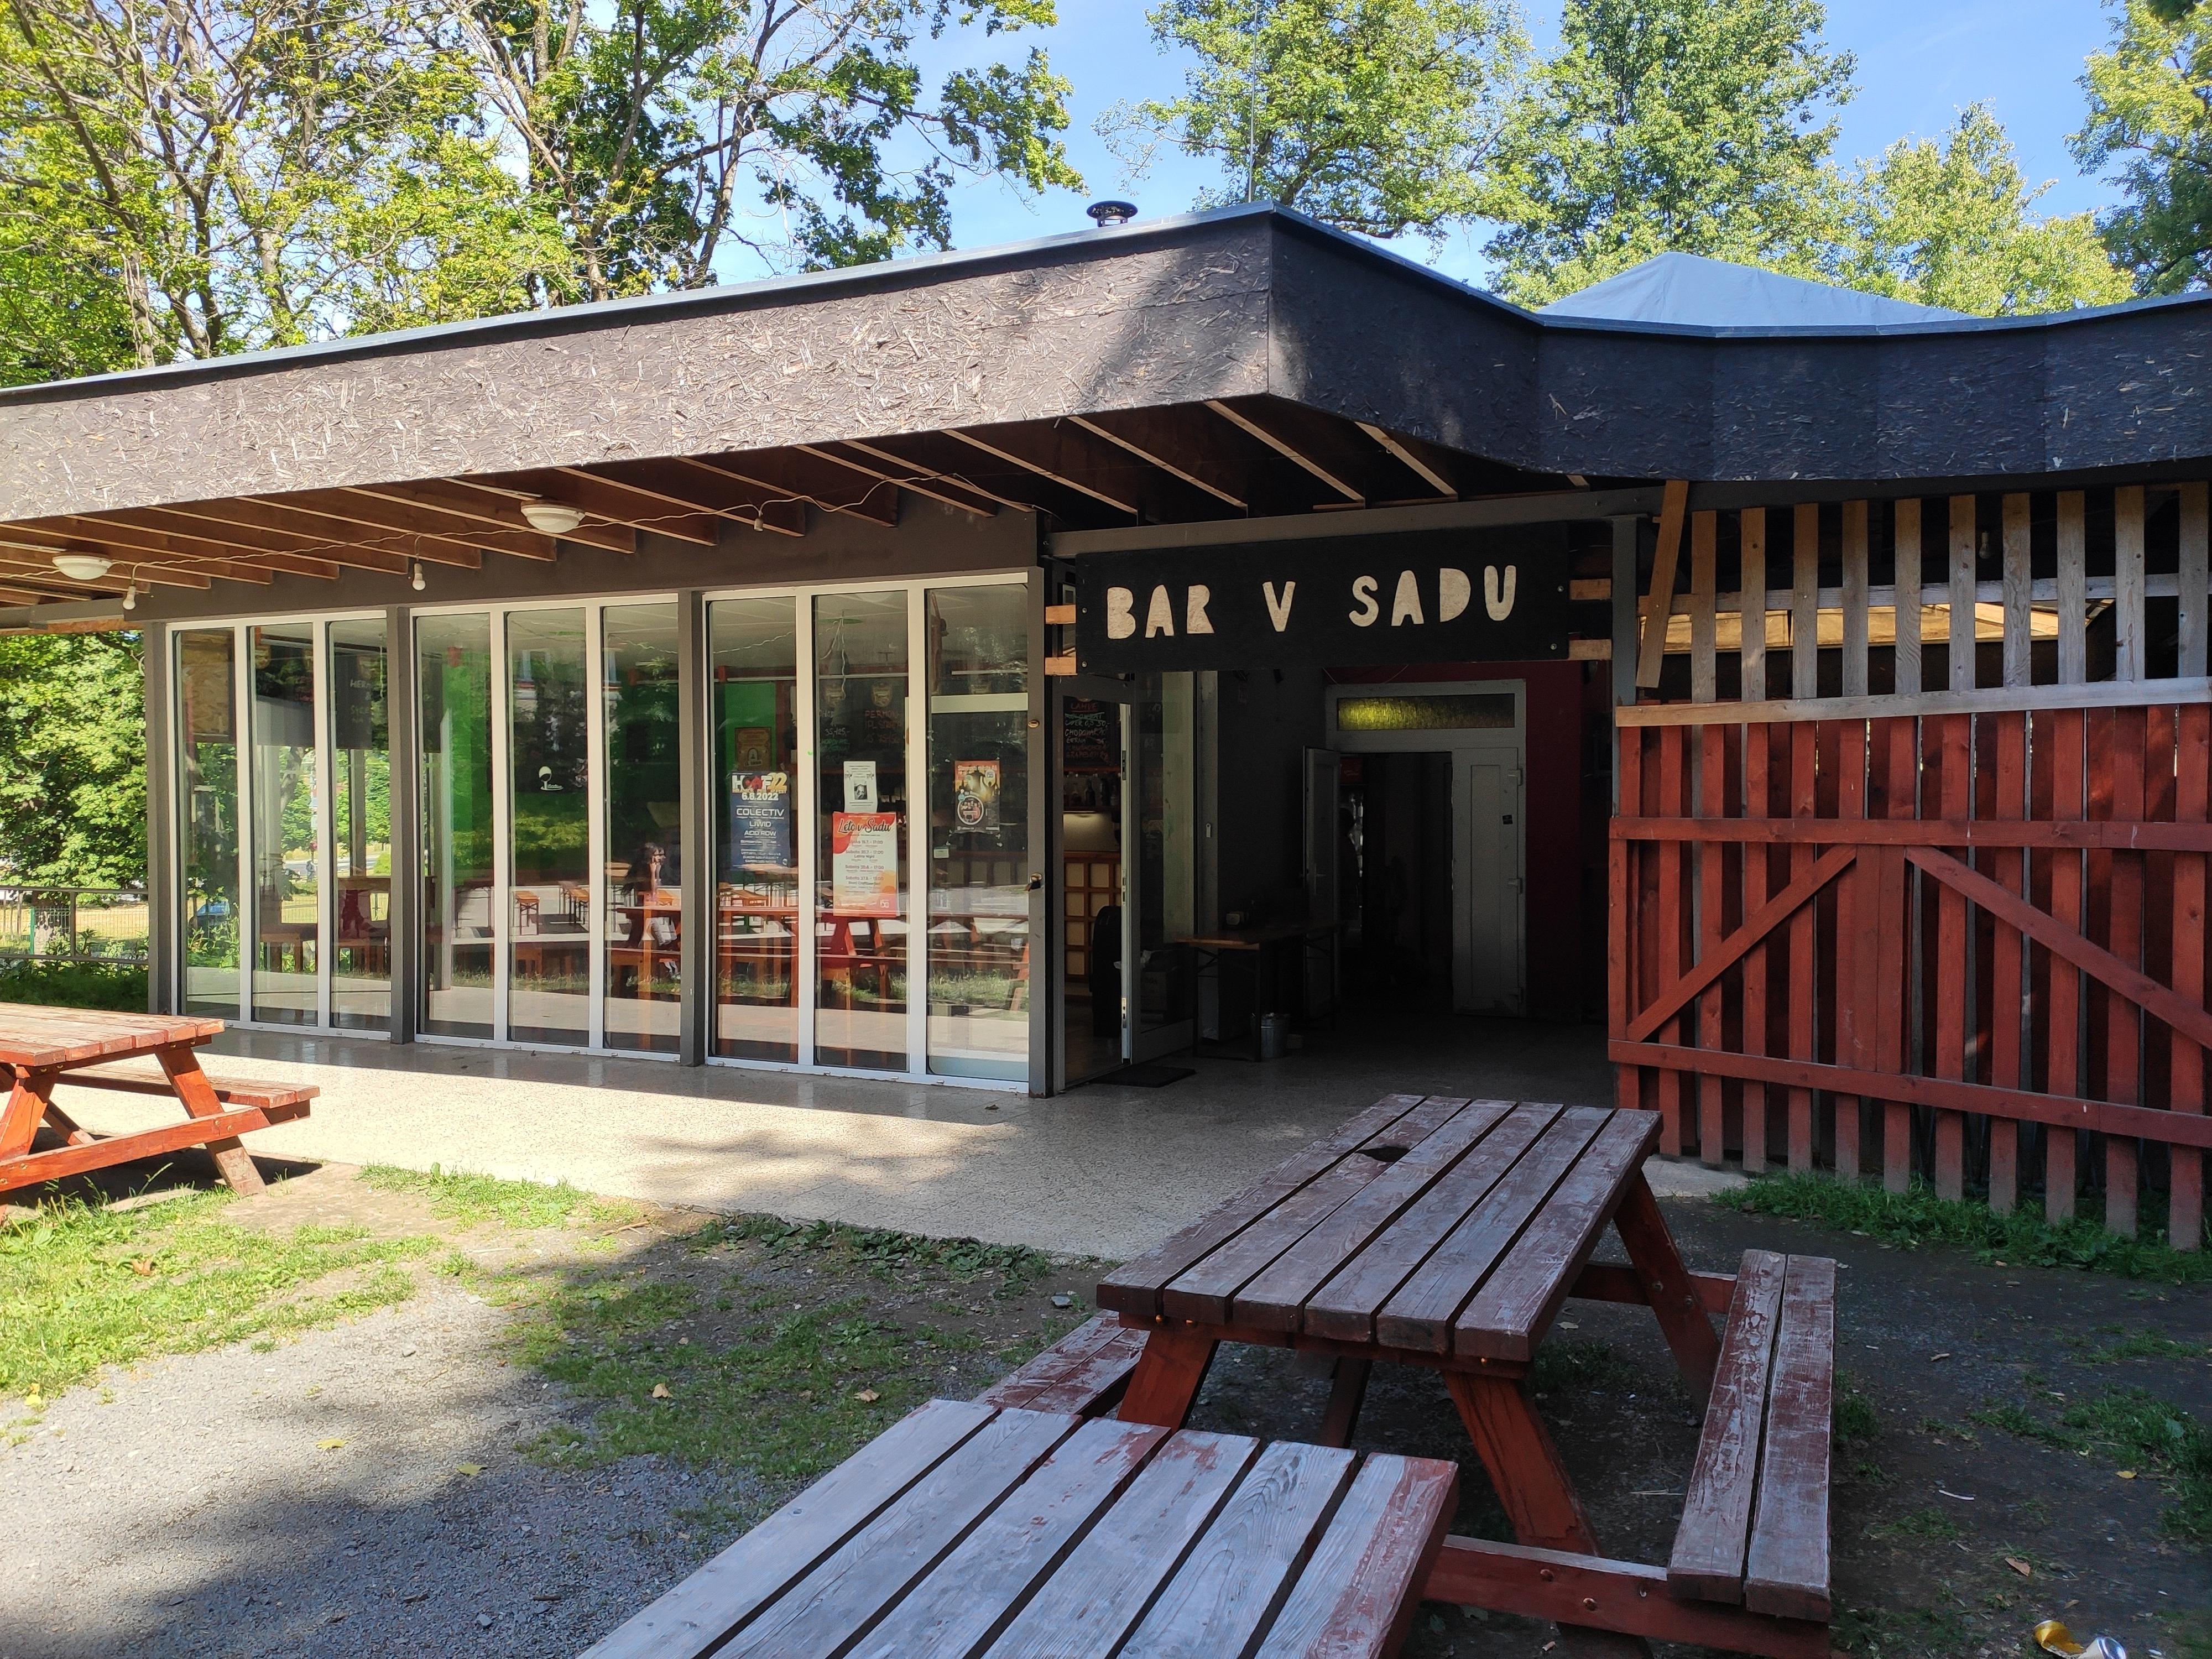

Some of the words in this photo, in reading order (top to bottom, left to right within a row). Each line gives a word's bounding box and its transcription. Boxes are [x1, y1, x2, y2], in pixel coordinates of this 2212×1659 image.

[1107, 585, 1215, 639] BAR
[1262, 581, 1296, 633] V
[1349, 565, 1517, 627] SADU
[742, 792, 779, 801] 6.8.2022
[736, 808, 785, 816] COLECTIV
[865, 818, 891, 833] Sadu
